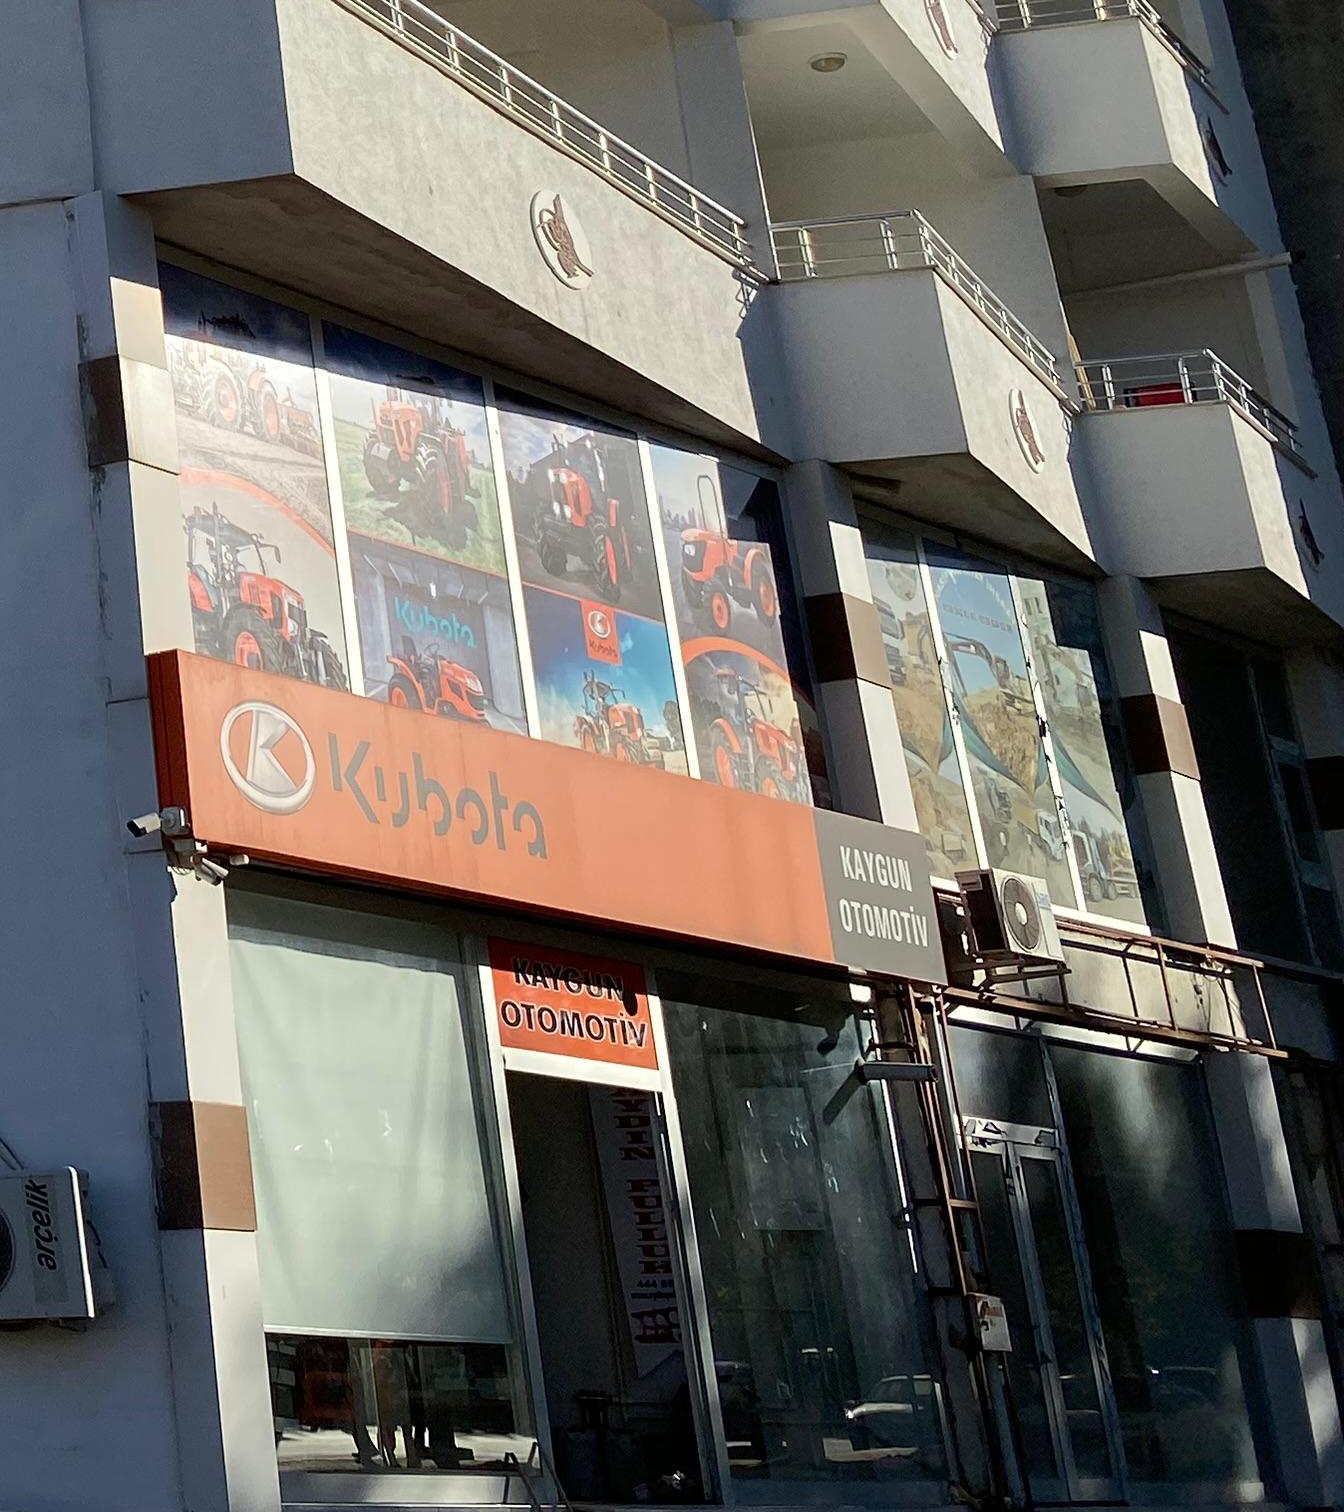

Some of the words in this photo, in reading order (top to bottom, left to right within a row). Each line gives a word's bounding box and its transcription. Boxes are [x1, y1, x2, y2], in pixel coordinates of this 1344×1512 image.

[393, 595, 477, 648] Kubota
[327, 732, 548, 859] Kubota
[839, 845, 913, 892] KAYGUN
[838, 898, 929, 948] OTOMOTİV
[501, 1000, 646, 1048] OTOMOTİV
[24, 1179, 60, 1271] arçelik
